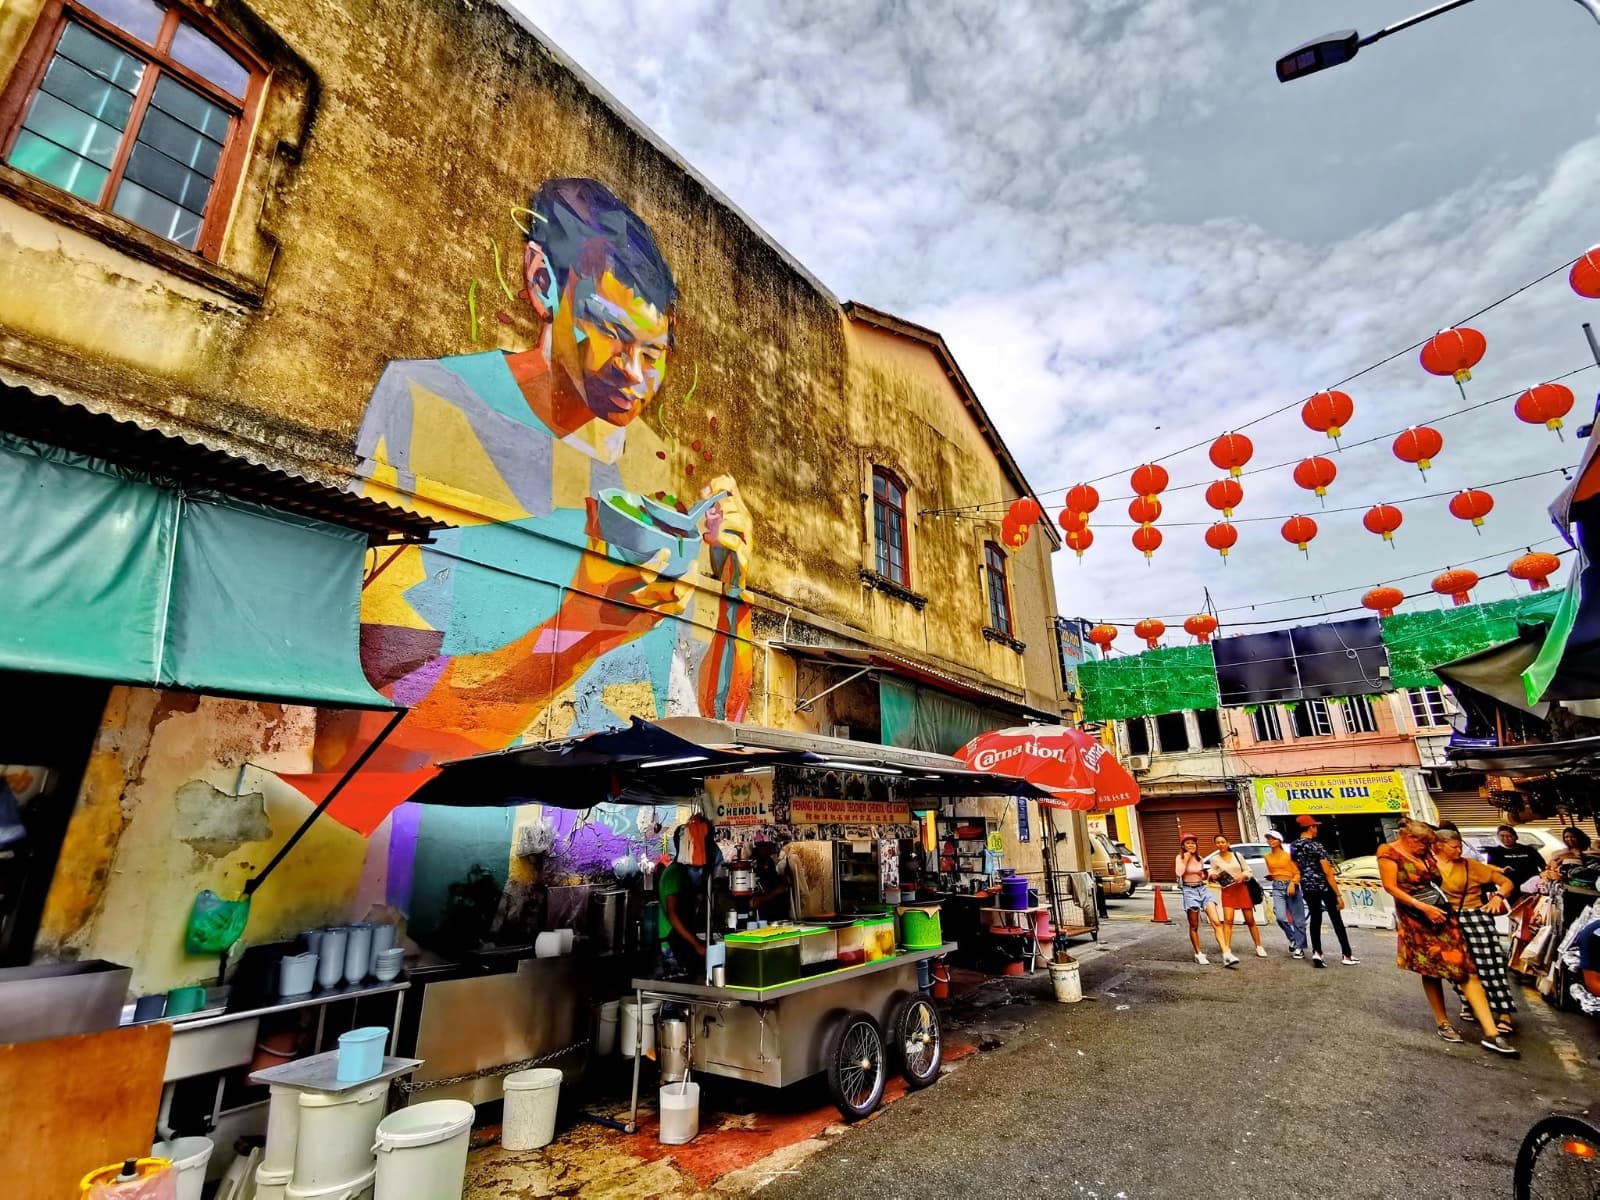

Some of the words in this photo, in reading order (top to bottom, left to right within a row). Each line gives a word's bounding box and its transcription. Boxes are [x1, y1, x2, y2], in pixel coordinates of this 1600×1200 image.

[974, 741, 1067, 771] Carnation
[1295, 780, 1317, 788] SWEET
[1327, 779, 1347, 787] SOUR
[1349, 775, 1393, 785] ENTERPRISE
[1285, 787, 1335, 801] JERUK
[1340, 786, 1369, 798] IBU
[717, 803, 766, 816] CHENDUL
[793, 800, 813, 811] PENANG
[814, 801, 827, 811] ROAD
[1350, 888, 1374, 907] MB
